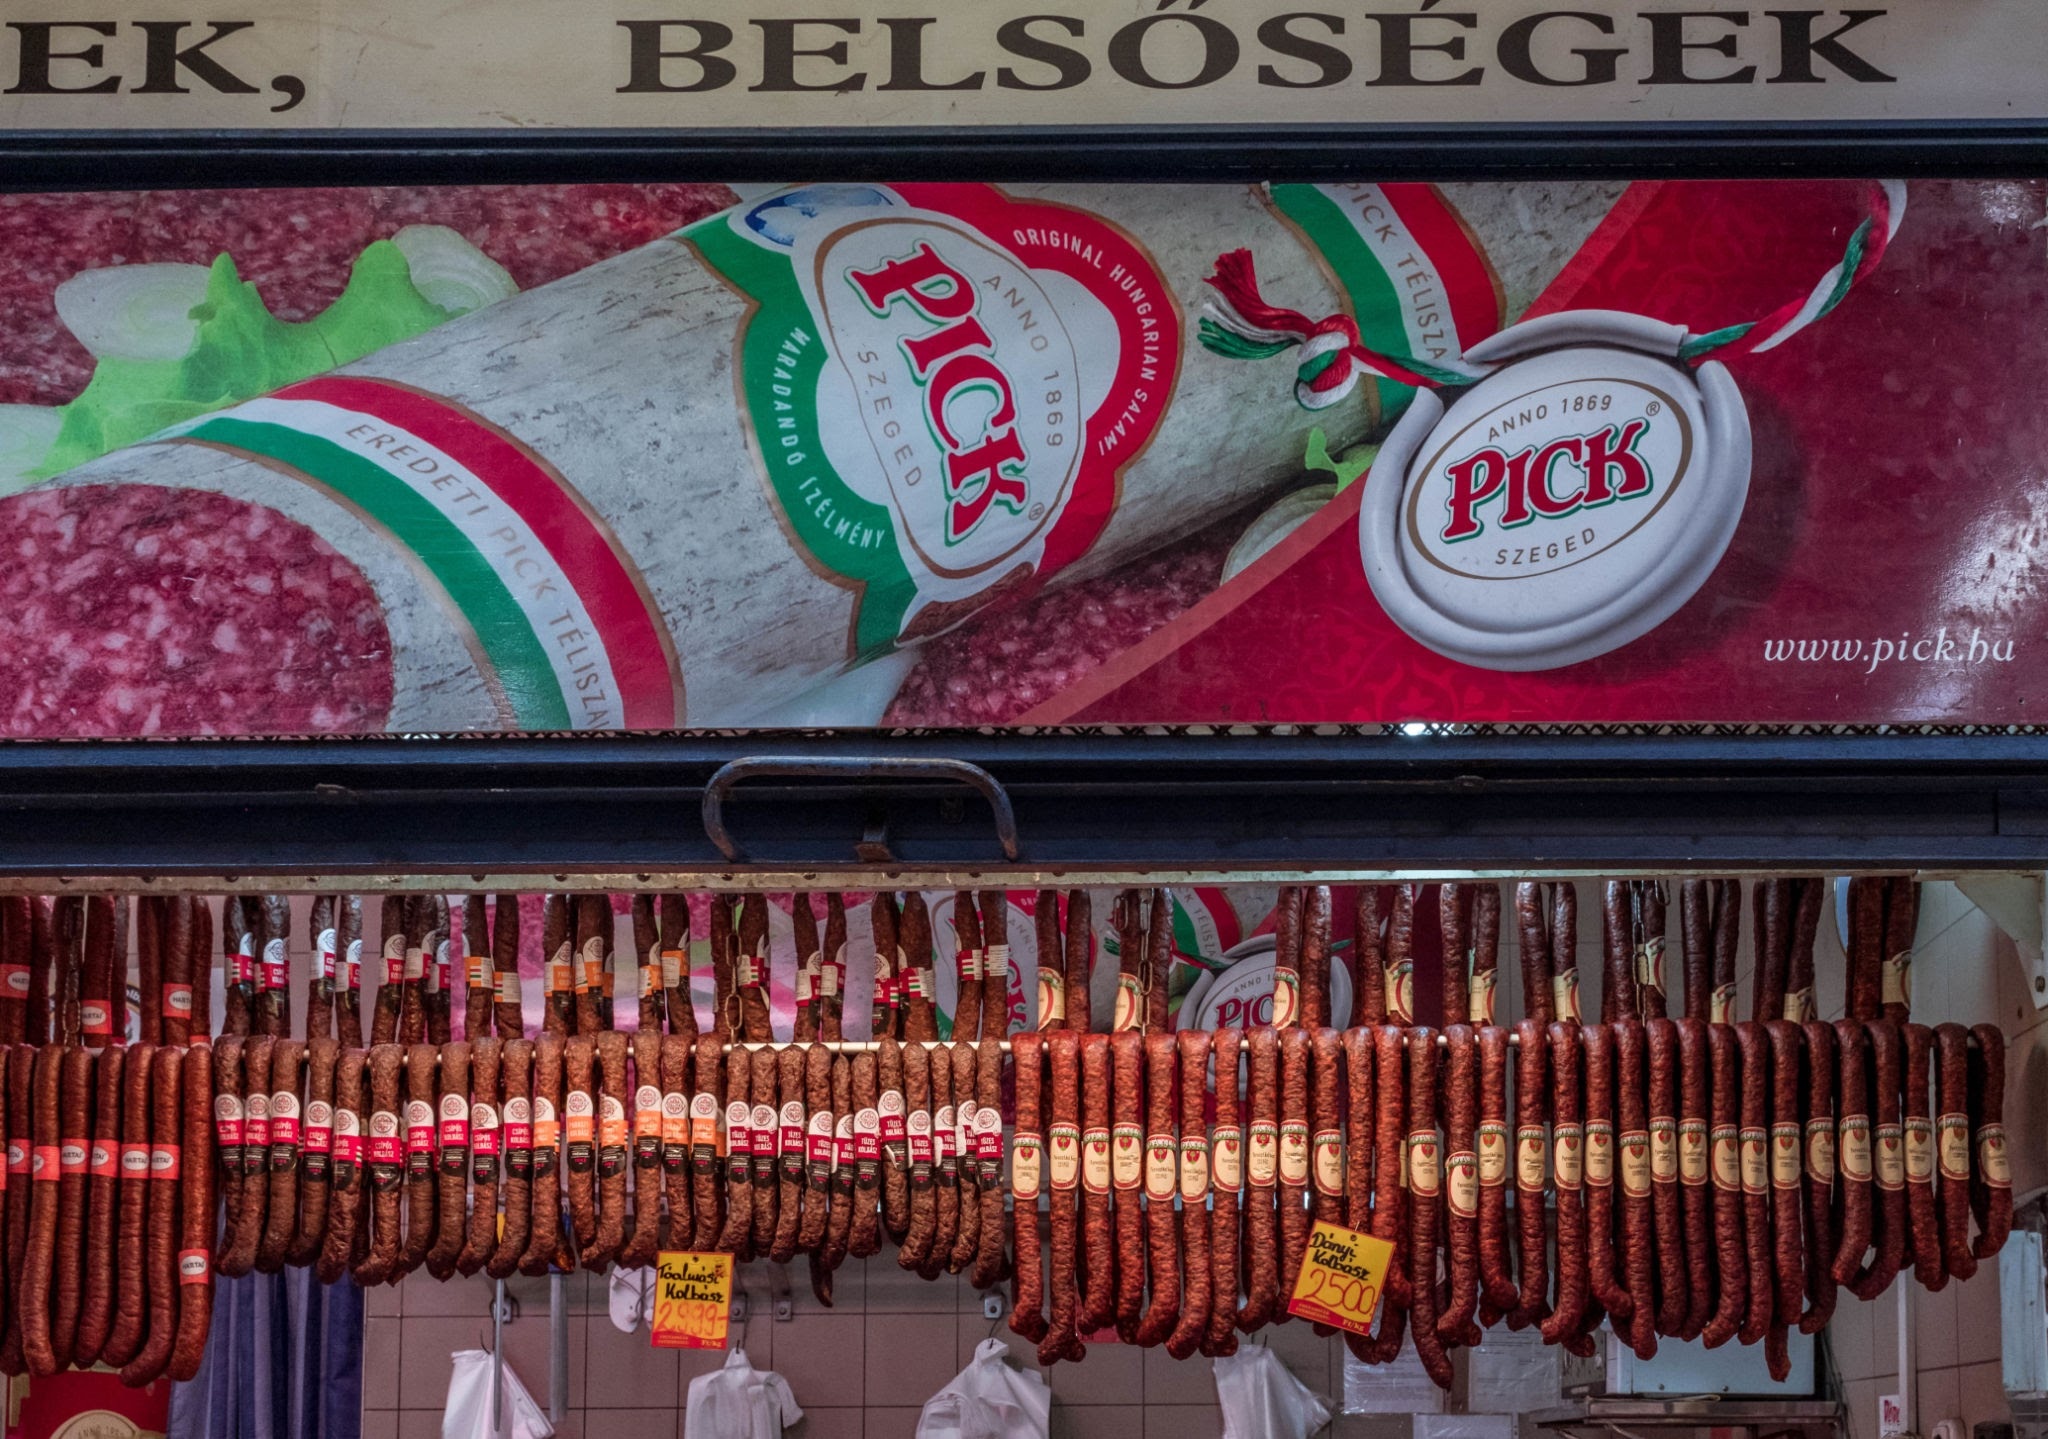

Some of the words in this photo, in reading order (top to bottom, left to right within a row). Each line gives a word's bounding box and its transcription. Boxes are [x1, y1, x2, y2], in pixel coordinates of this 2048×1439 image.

[3, 20, 306, 112] EK,
[614, 0, 1898, 94] BELSŐSÉGEK
[1013, 228, 1103, 268] ORIGINAL
[982, 274, 1048, 354] ANNO
[1042, 369, 1064, 448] 1869
[1109, 264, 1160, 381] HUNGARIAN
[772, 326, 812, 467] MARADANDÓ
[845, 240, 1030, 545] PICK
[857, 349, 923, 488] SZEGED
[1098, 388, 1149, 457] SALAMI
[1488, 404, 1549, 442] ANNO
[1561, 394, 1613, 415] 1869
[345, 423, 489, 517] EREDETI
[489, 525, 558, 602] PICK
[1441, 417, 1653, 544] PICK
[1494, 527, 1596, 566] SZEGED
[1763, 627, 2016, 674] www.pick.hu
[1216, 993, 1275, 1032] PIC
[1309, 1232, 1359, 1262] Dányi
